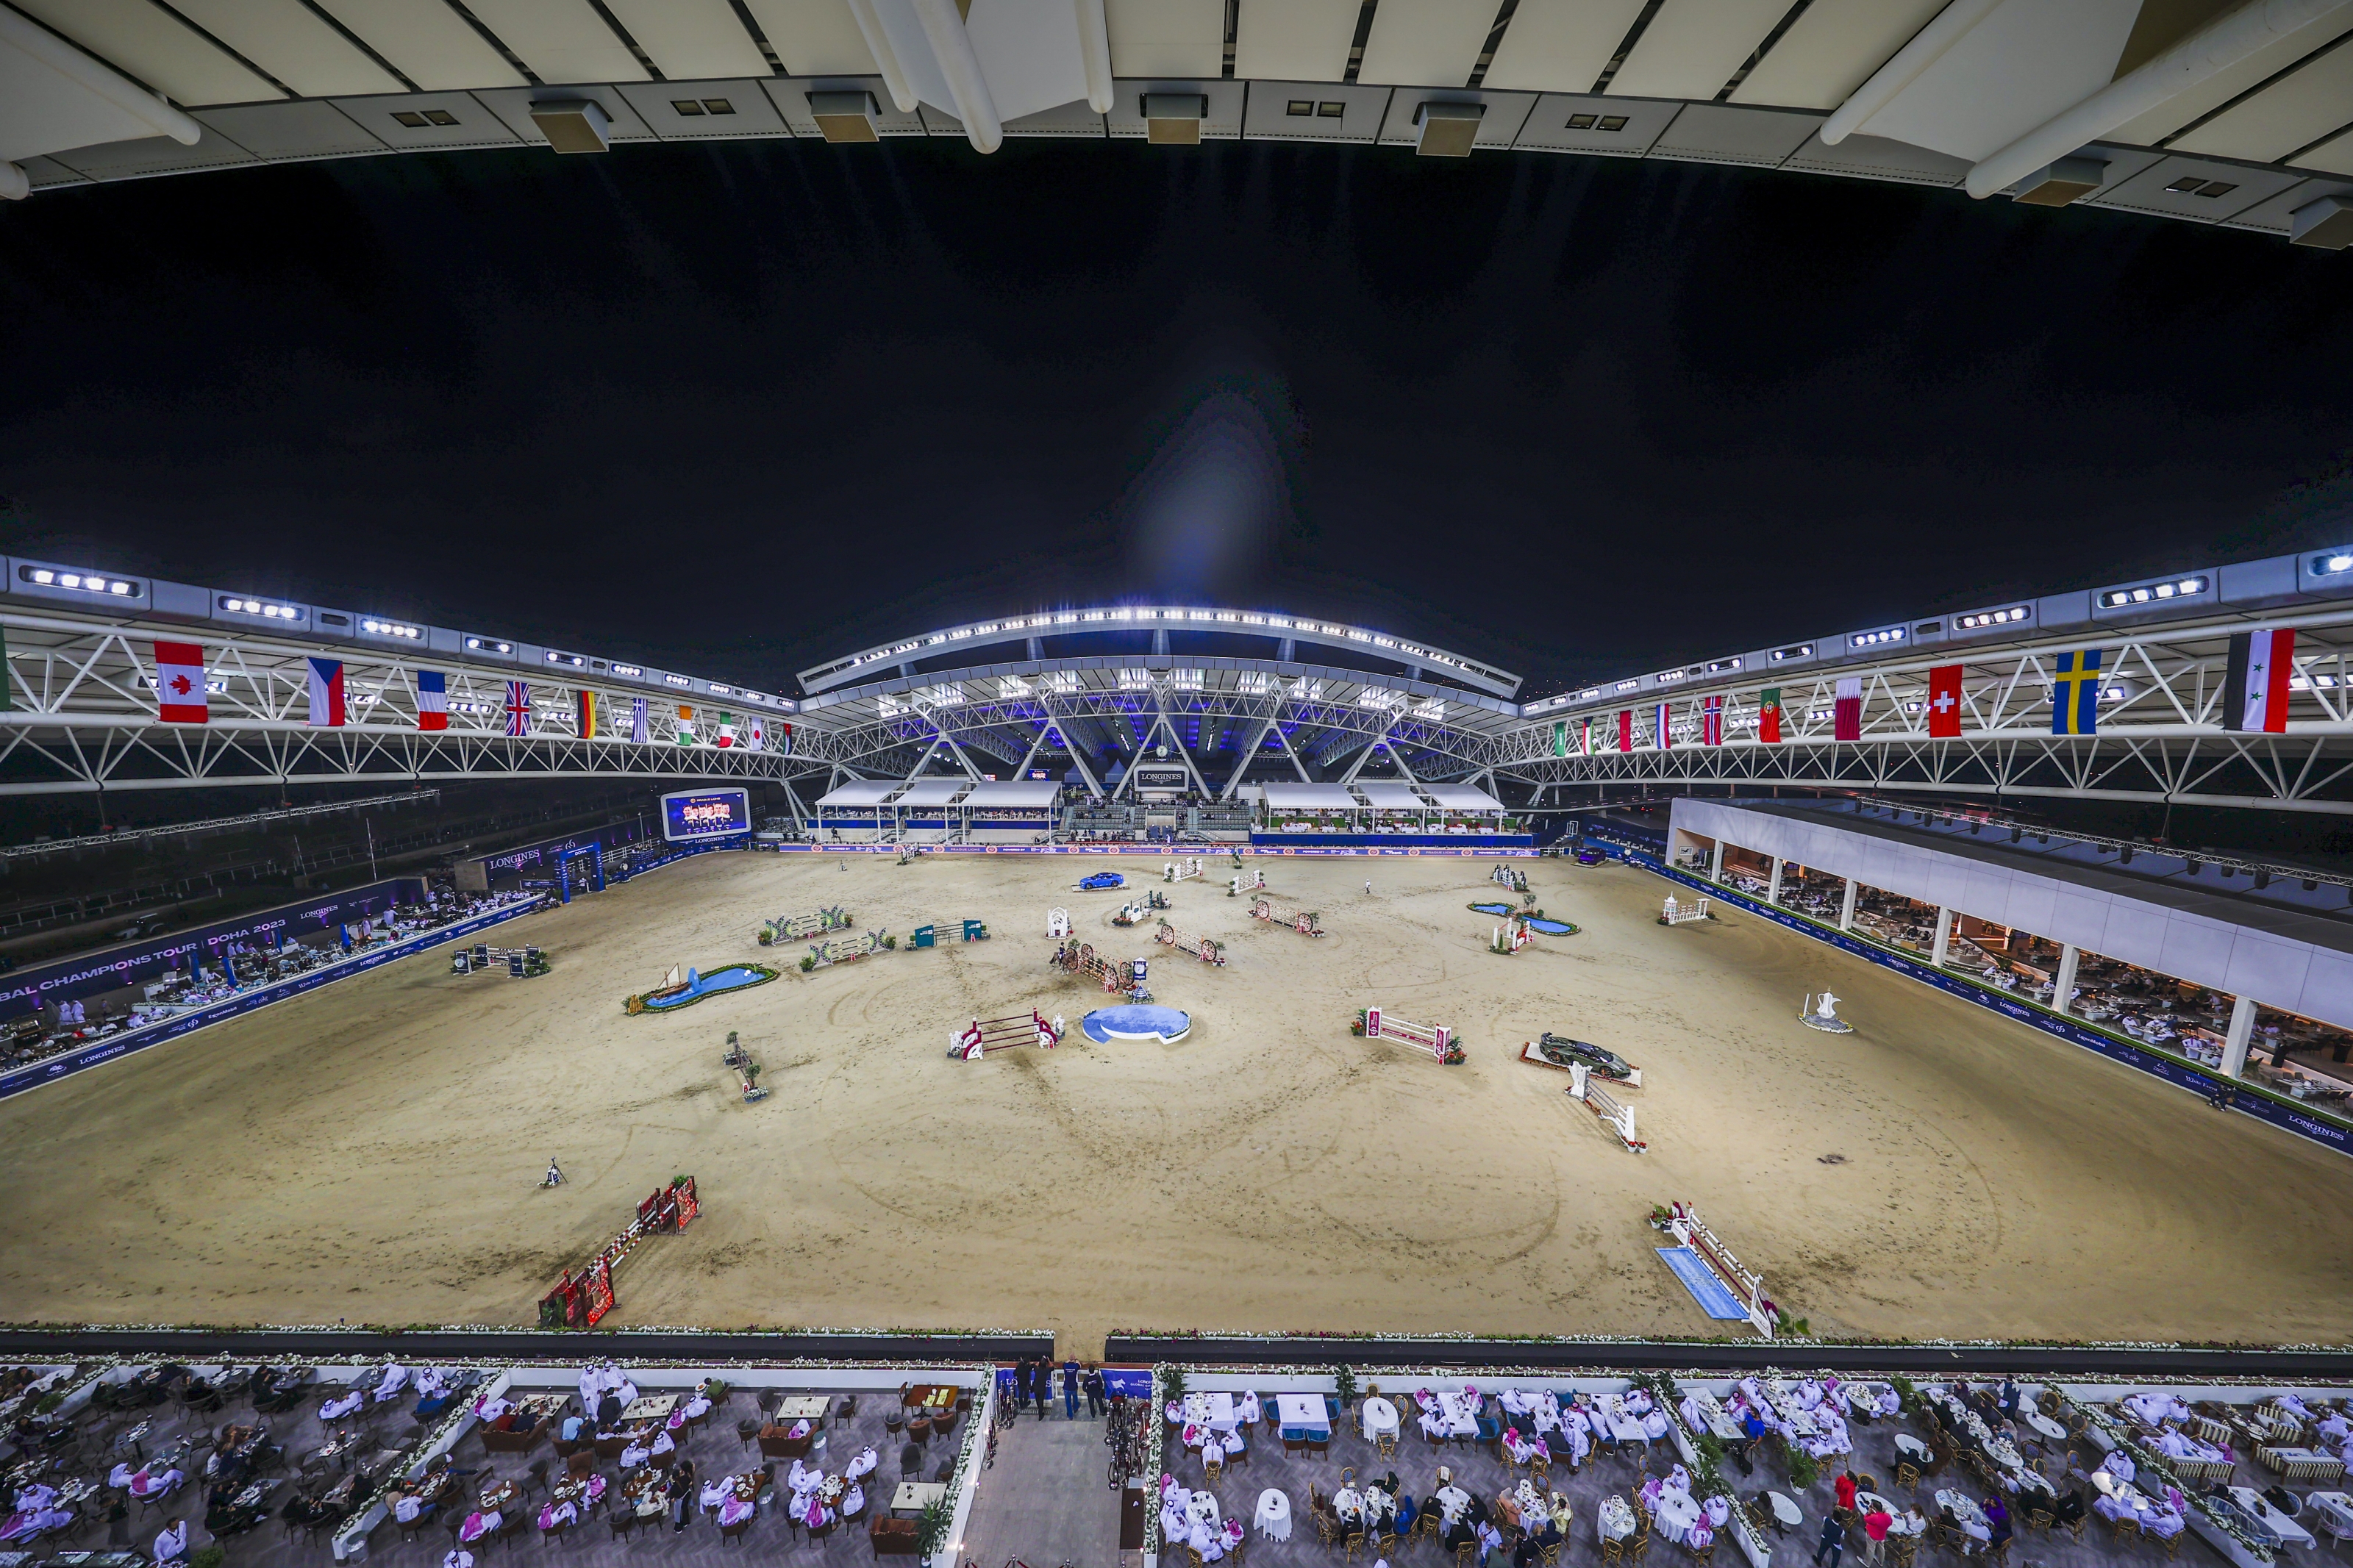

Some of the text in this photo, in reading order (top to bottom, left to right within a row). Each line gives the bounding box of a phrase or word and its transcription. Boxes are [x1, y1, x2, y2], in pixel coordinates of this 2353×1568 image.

[695, 836, 725, 844] LONGINES
[490, 849, 540, 869] LONGINES
[300, 905, 338, 919] LONGINES
[458, 923, 479, 934] LONGINES
[40, 954, 152, 990] CHAMPIONS
[153, 942, 198, 960] TOUR
[207, 929, 250, 945] DOHA
[253, 919, 286, 934] 2023
[360, 953, 387, 966] LONGINES
[1886, 957, 1910, 970] LONGINES
[208, 1006, 238, 1019] ExxonMobil
[1999, 1002, 2030, 1017] LONGINES
[2077, 1034, 2106, 1048] ExxonMobil
[79, 1045, 126, 1064] LONGINES
[2185, 1075, 2218, 1092] White Event
[2288, 1114, 2344, 1141] LONGINES
[1006, 1378, 1051, 1387] LOIS
